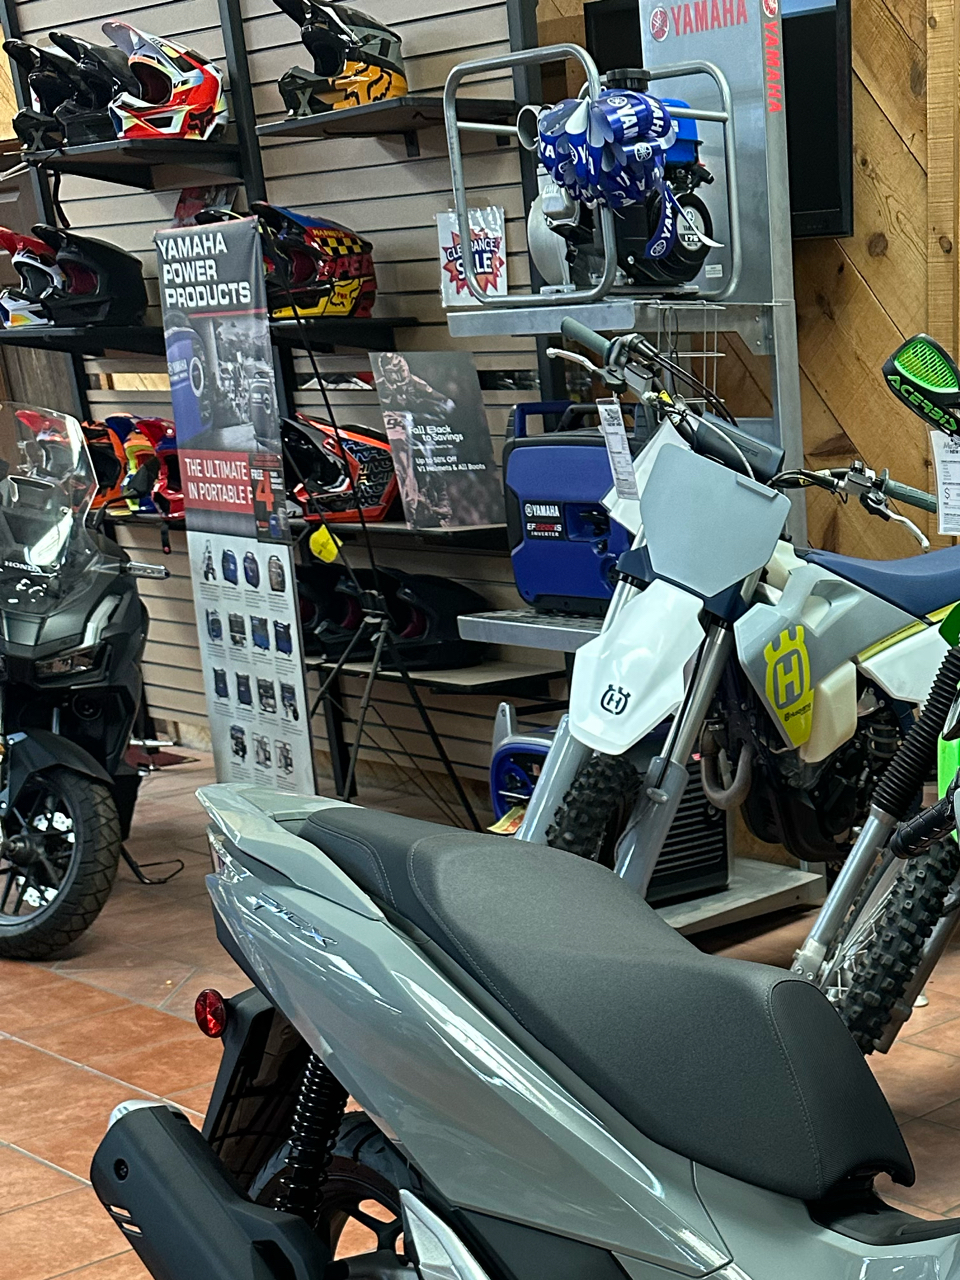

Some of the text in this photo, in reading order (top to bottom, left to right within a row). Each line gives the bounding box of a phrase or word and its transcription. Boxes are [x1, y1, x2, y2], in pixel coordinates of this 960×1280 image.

[671, 0, 748, 36] YAMAHA
[764, 21, 783, 113] YAMAHA
[157, 232, 228, 260] YAMAHA
[446, 238, 496, 261] CLEANCE
[684, 234, 699, 242] 175
[163, 259, 218, 284] POWER
[455, 252, 493, 279] SLE
[164, 281, 251, 308] PRODUCTS
[887, 375, 958, 431] ACERBIS
[409, 425, 452, 435] Fall Back
[422, 432, 464, 443] to Savings
[184, 458, 203, 478] THE
[203, 459, 249, 481] ULTIMATE
[446, 455, 458, 463] Off
[458, 463, 468, 471] All
[468, 463, 486, 471] Boots
[187, 481, 199, 500] IN
[199, 482, 247, 505] PORTABLE
[256, 471, 275, 511] 4
[532, 504, 560, 517] YAMAHA
